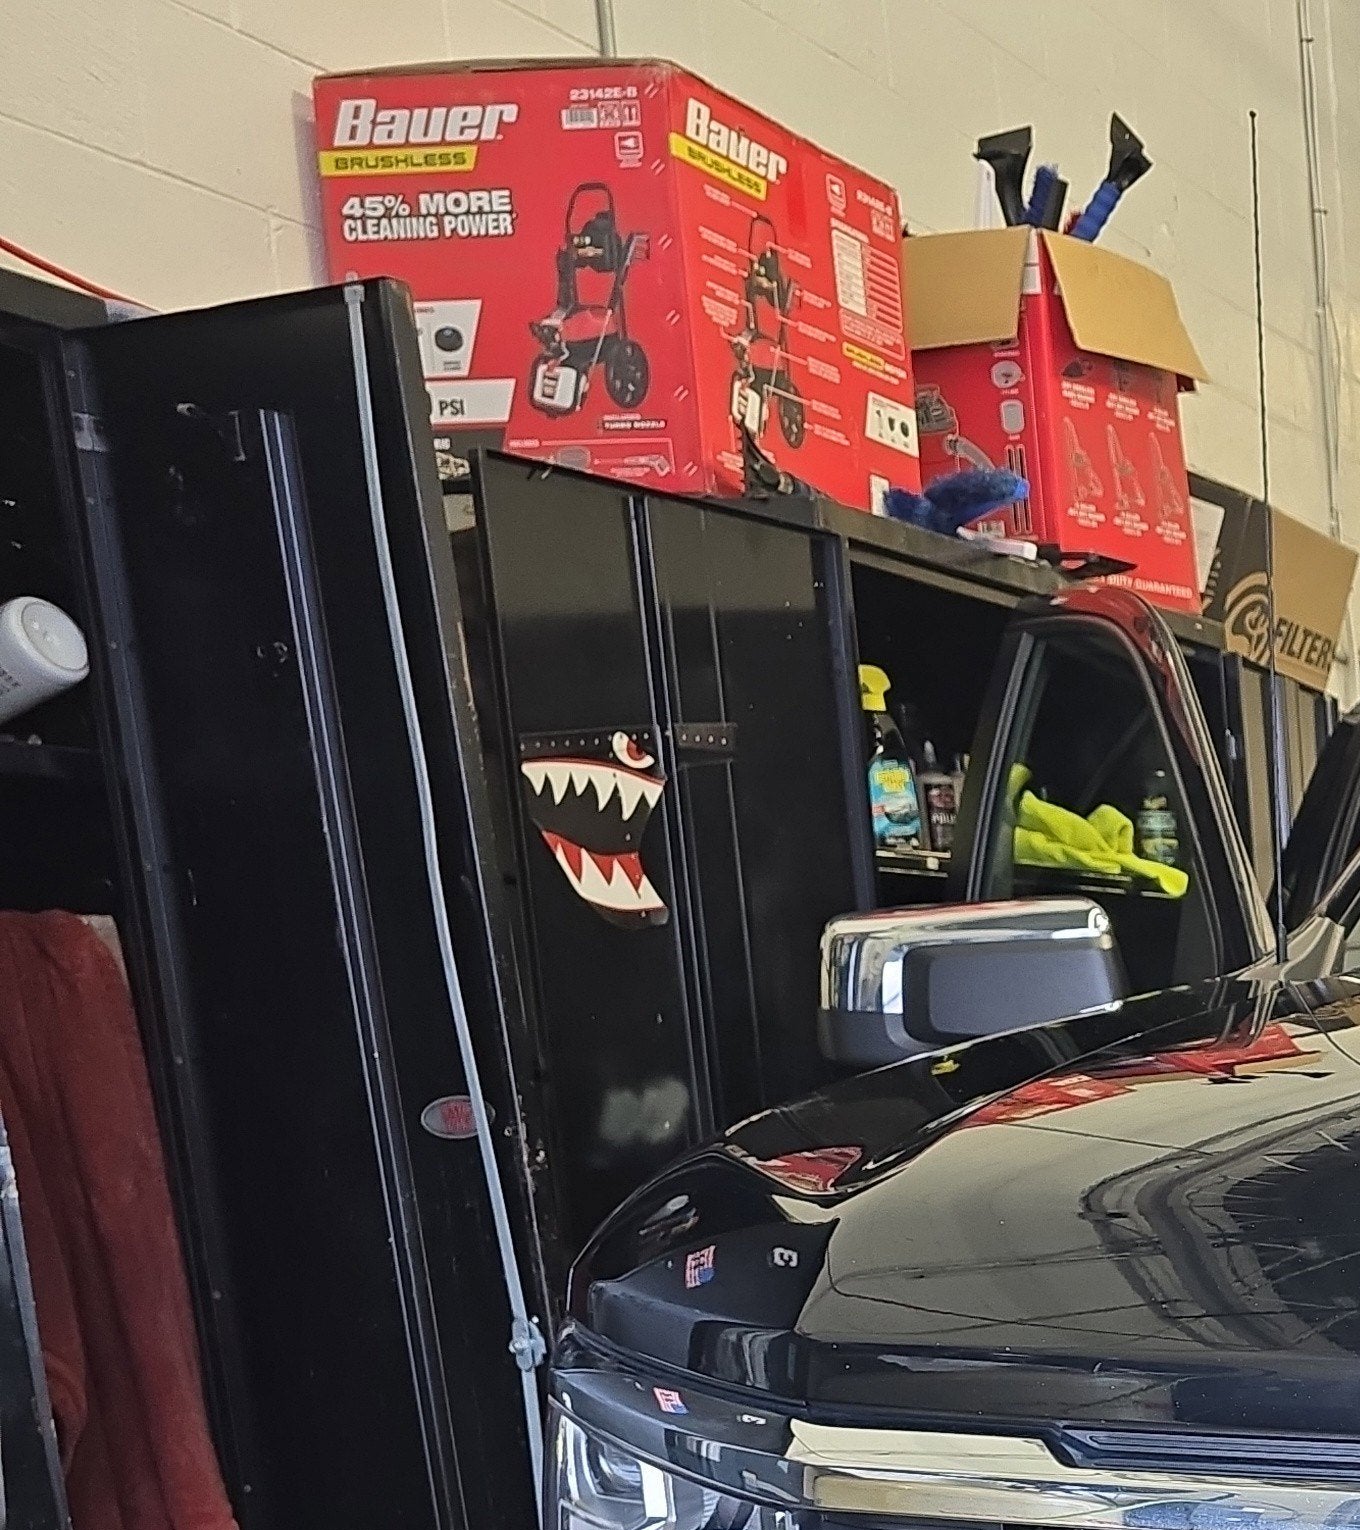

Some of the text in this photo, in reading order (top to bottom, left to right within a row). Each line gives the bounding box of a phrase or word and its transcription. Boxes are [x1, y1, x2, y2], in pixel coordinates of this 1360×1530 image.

[333, 98, 519, 147] Bauer
[685, 97, 788, 184] Bauer
[334, 151, 467, 171] BRUSHLESS
[686, 145, 763, 194] BRUSHLESS
[342, 188, 513, 218] 45% MORE
[343, 212, 515, 242] CLEANING POWER
[438, 399, 465, 417] PSI
